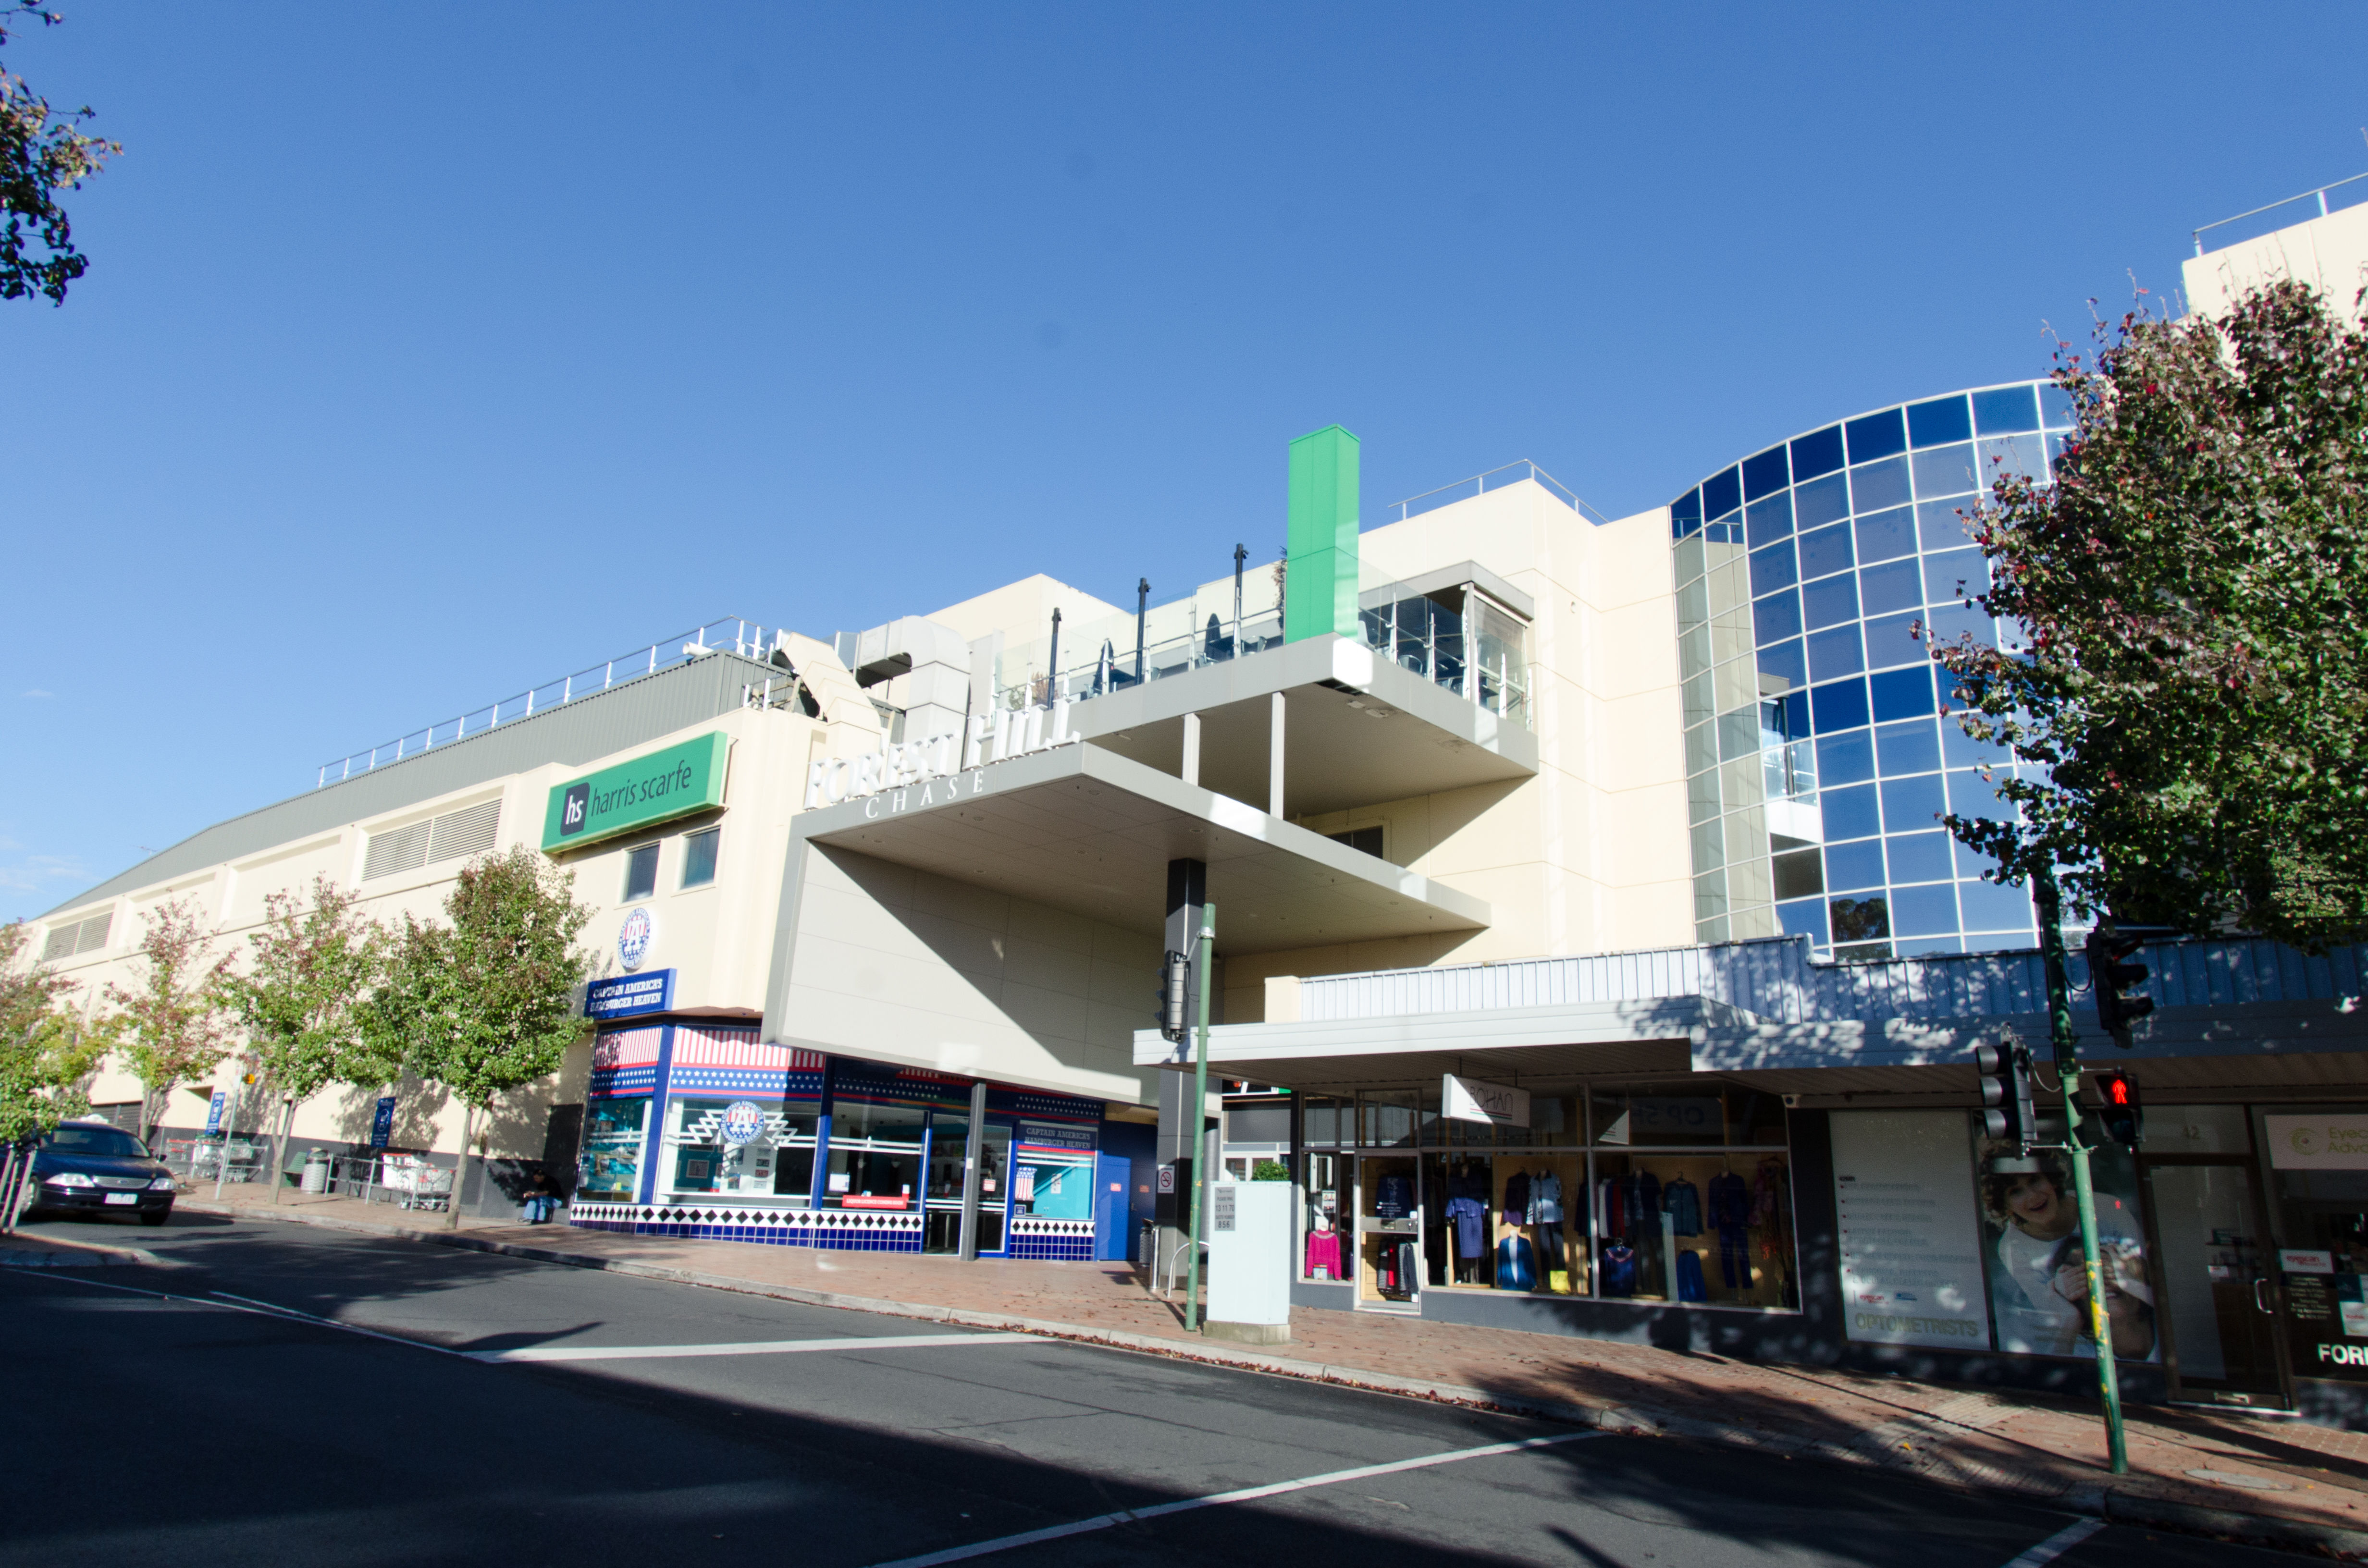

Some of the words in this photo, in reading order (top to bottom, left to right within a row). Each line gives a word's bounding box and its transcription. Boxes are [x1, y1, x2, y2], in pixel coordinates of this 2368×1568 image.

[803, 729, 961, 810] FOREST
[962, 697, 1081, 771] HILL
[566, 795, 583, 825] hs
[591, 779, 637, 817] harris
[639, 760, 691, 802] scarfe
[865, 770, 984, 819] CHASE
[624, 920, 643, 952] A
[593, 984, 624, 999] CAPTAIN
[625, 978, 663, 994] AMERICA'S
[633, 992, 662, 1006] HEAVEN
[729, 1110, 755, 1132] A
[1026, 1127, 1055, 1136] CAPTAIN
[746, 1125, 763, 1143] HEAVEN
[1024, 1137, 1065, 1147] HAMBURGER
[1066, 1140, 1091, 1149] HEAVEN
[2183, 1125, 2199, 1140] 42
[1856, 1313, 1978, 1337] OPTOMETRISTS
